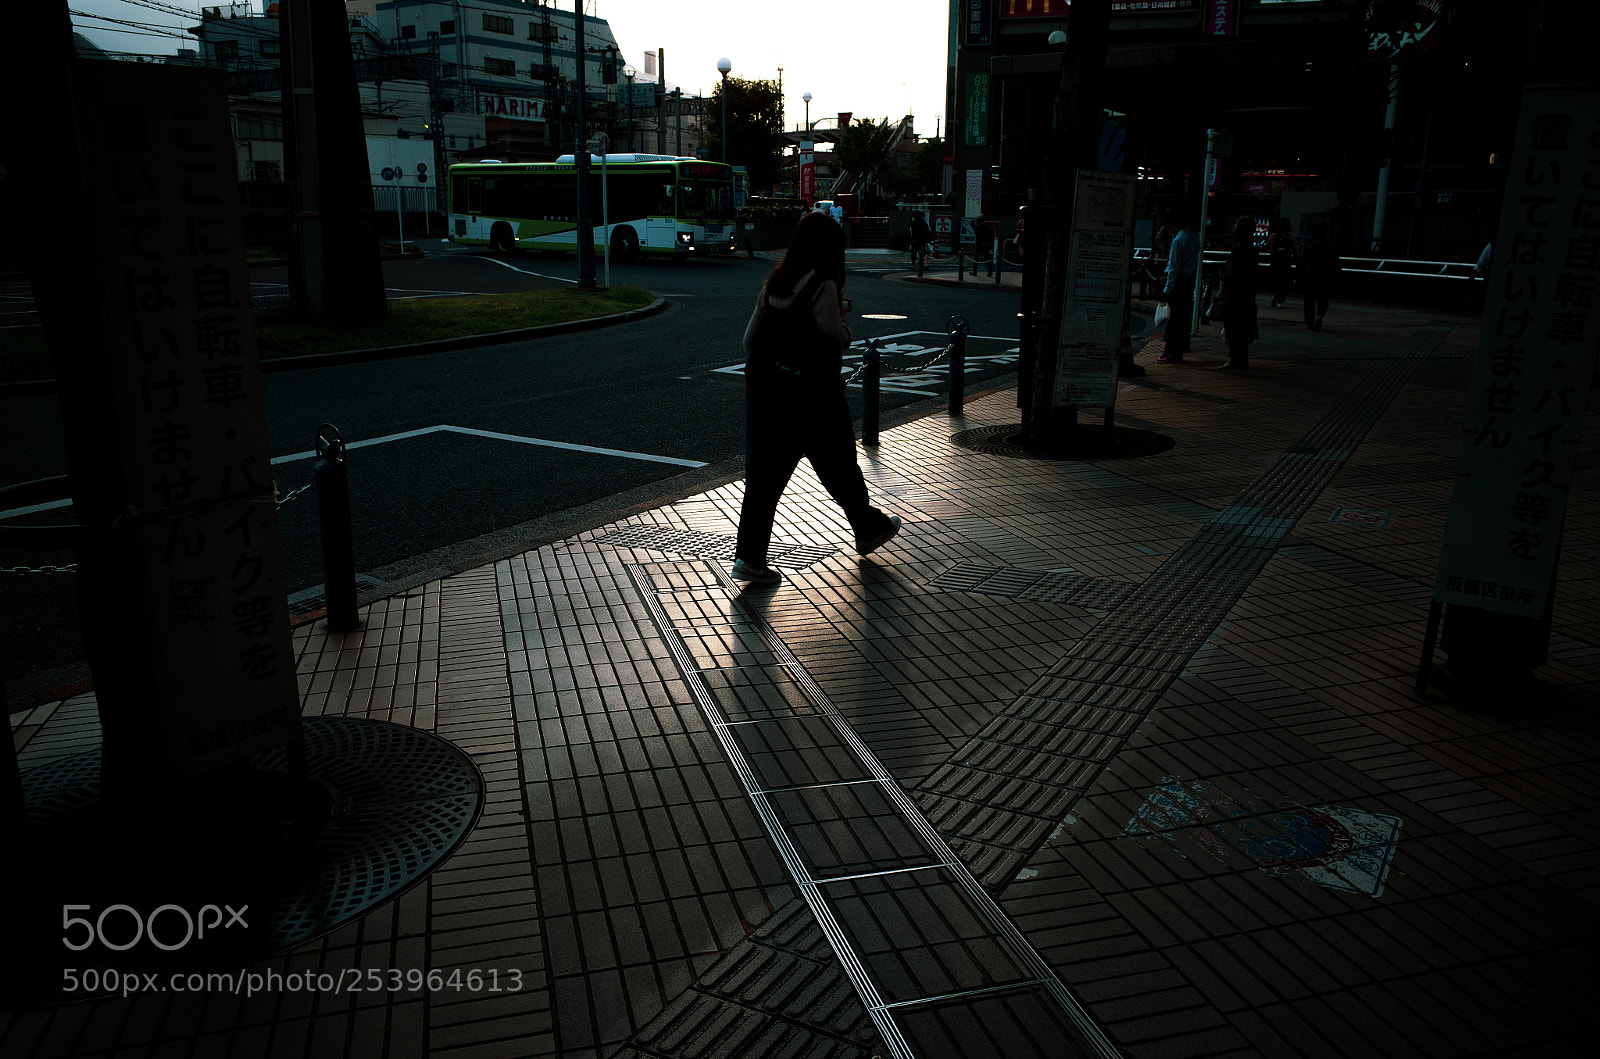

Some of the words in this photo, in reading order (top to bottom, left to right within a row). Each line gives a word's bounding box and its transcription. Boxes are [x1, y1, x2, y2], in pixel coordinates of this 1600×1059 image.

[1474, 114, 1574, 449] 置いてはいけません
[1446, 575, 1536, 605] 板橋区役所
